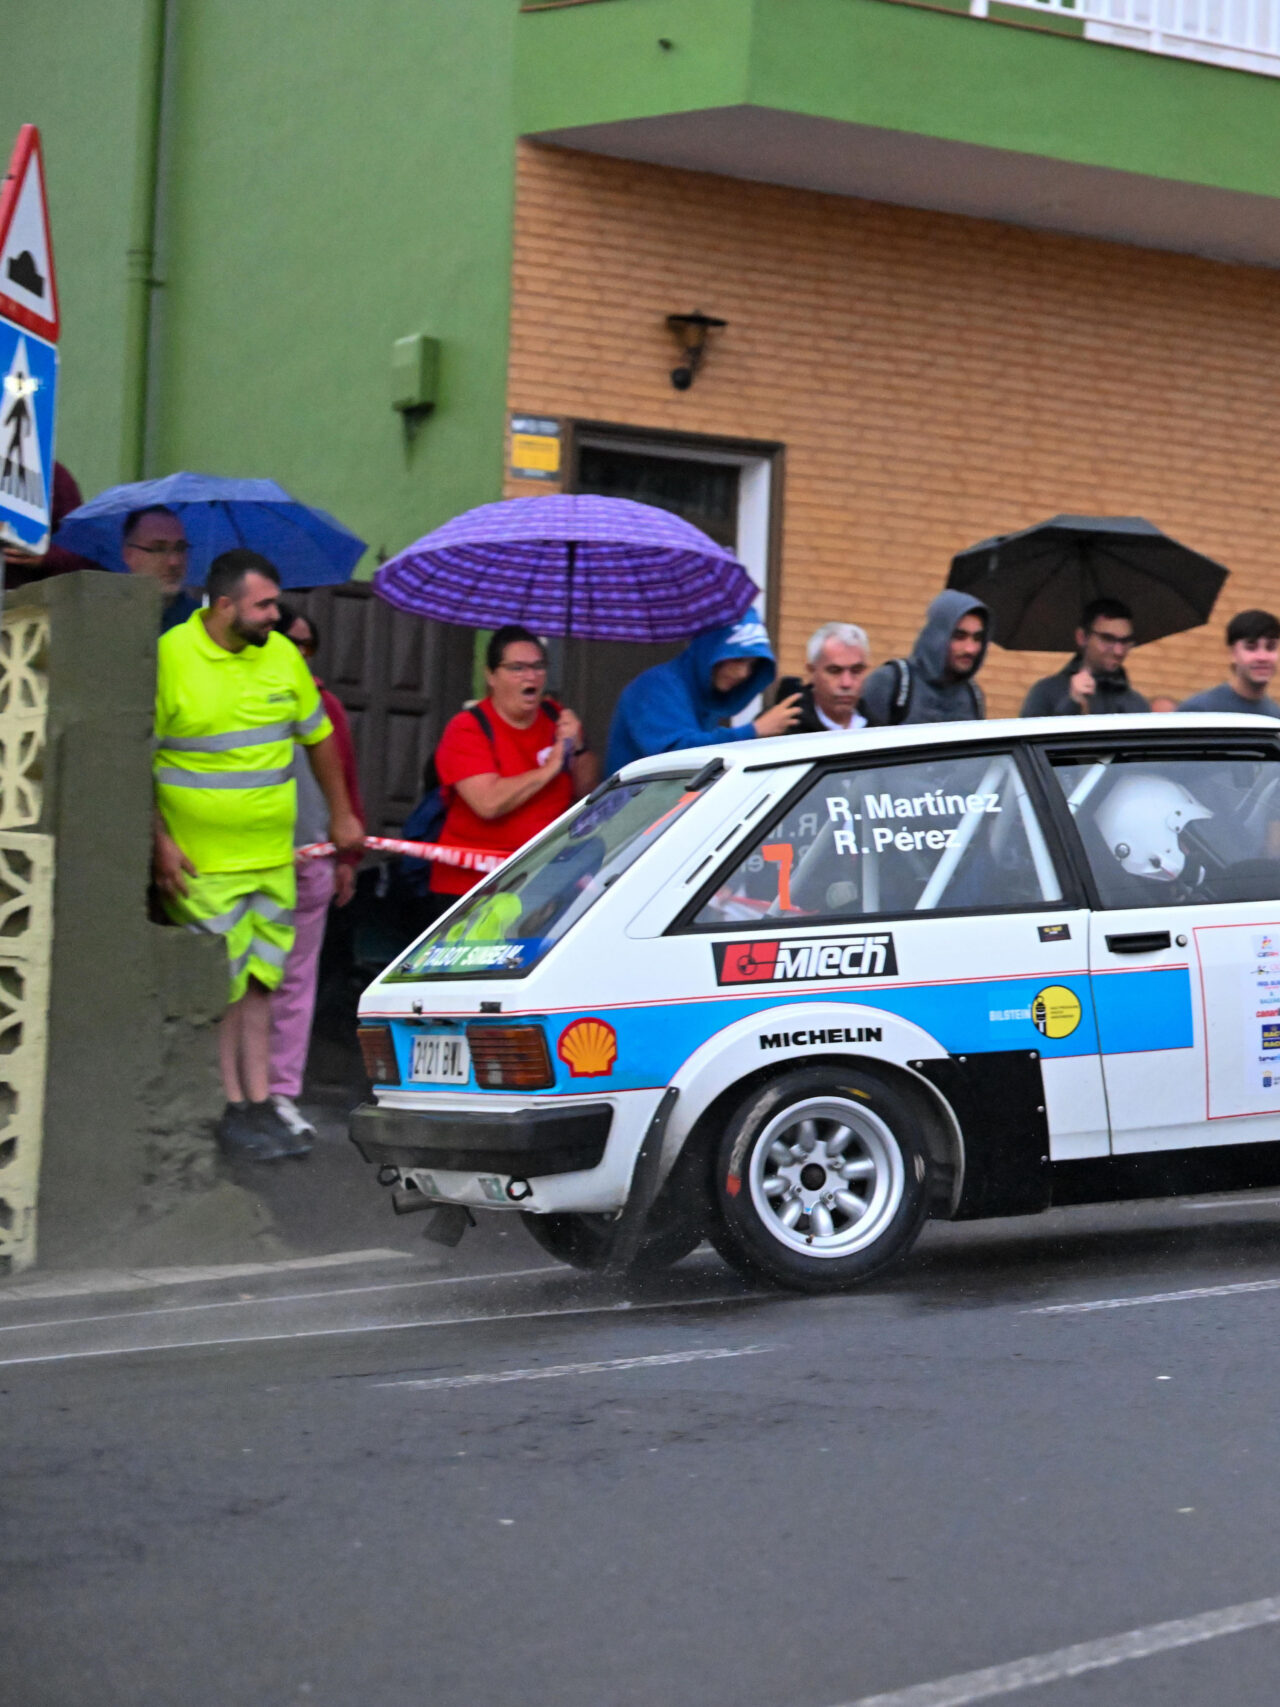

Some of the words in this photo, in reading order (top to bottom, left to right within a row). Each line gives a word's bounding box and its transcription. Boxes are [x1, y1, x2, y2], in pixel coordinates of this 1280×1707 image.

[826, 797, 862, 821] R.
[864, 789, 1002, 820] Martínez
[833, 829, 870, 854] R.
[872, 826, 961, 853] Pérez
[759, 1027, 882, 1049] MICHELIN
